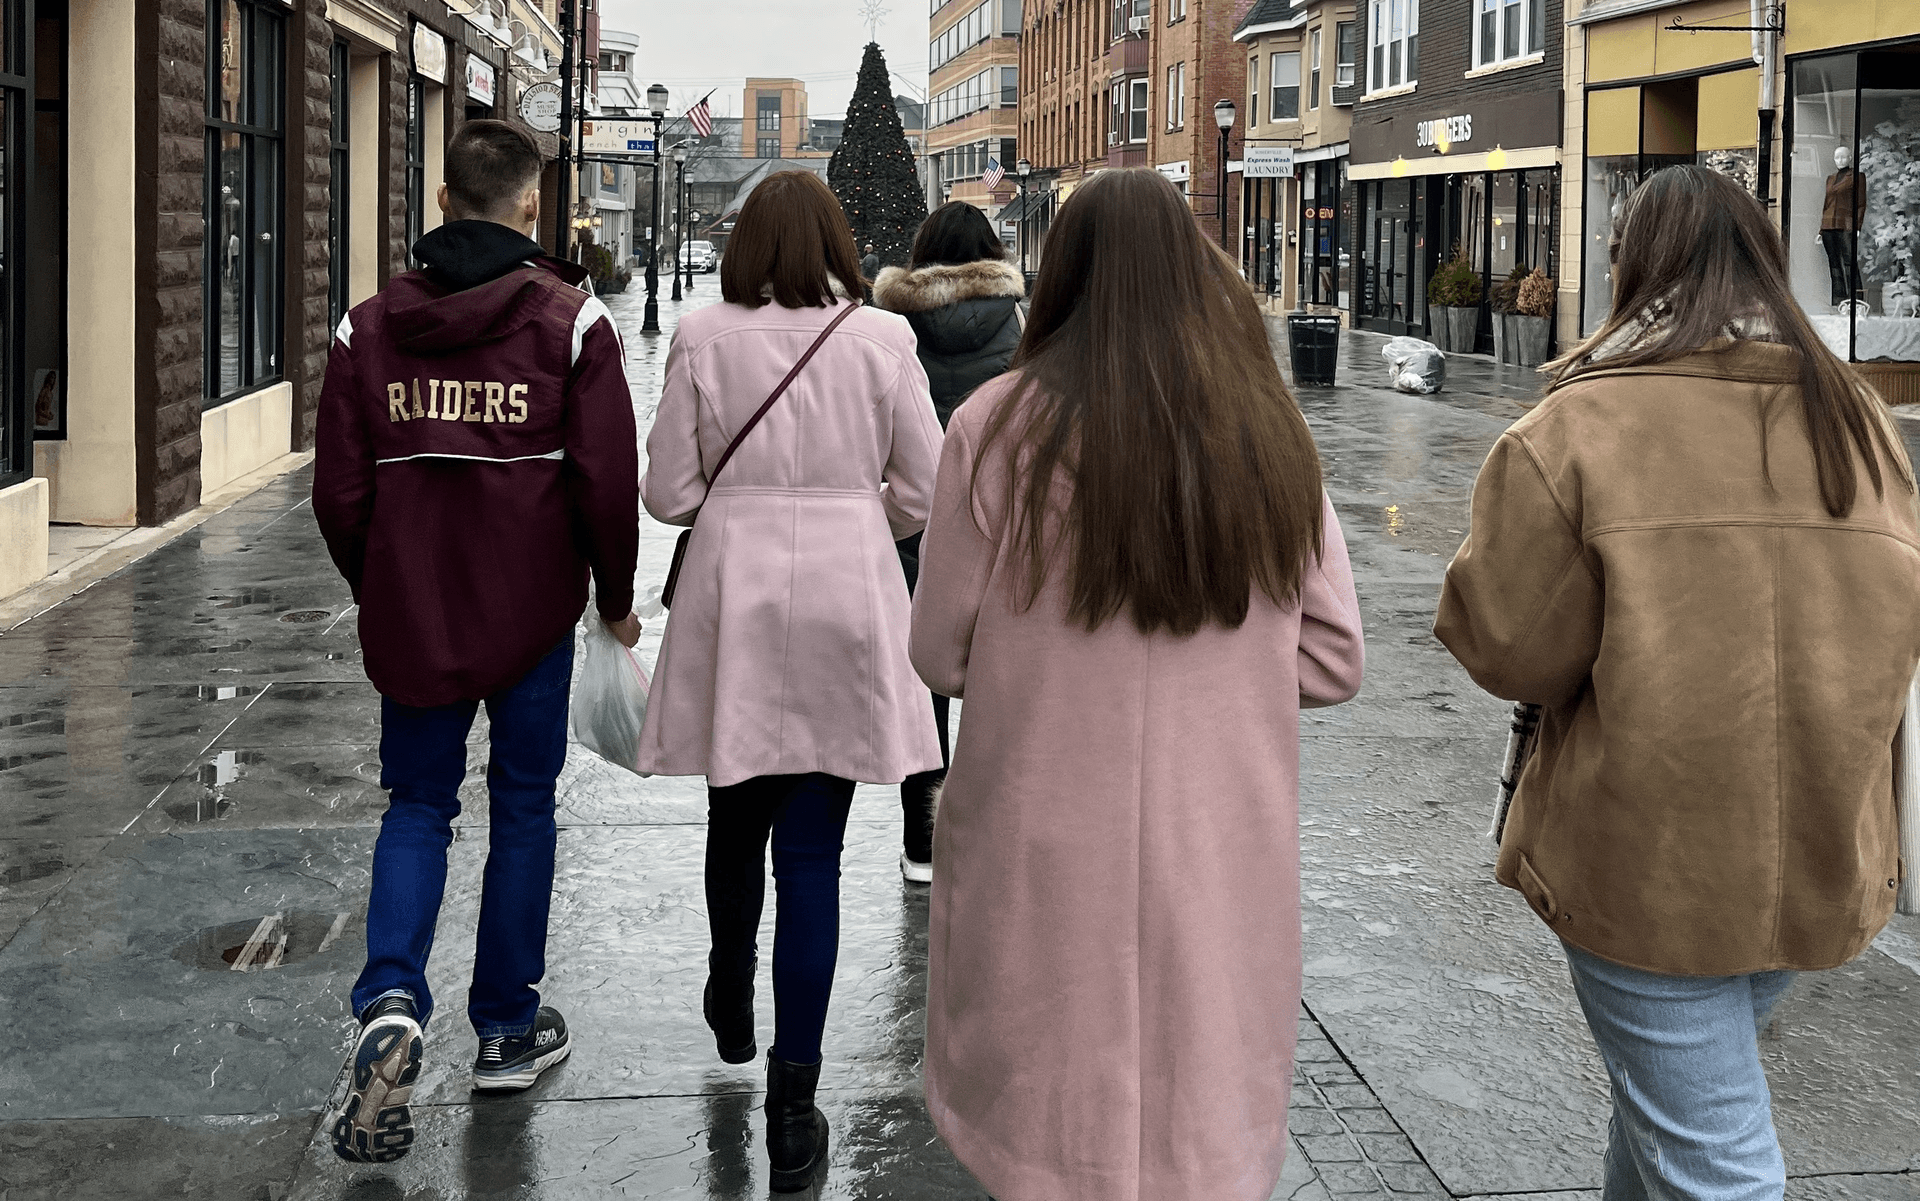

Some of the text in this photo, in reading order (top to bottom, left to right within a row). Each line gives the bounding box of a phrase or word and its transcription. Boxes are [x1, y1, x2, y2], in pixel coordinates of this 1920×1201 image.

[523, 85, 549, 109] DIVISION
[583, 140, 617, 149] rench
[1247, 166, 1290, 174] LAUNDRY
[1305, 208, 1333, 219] OEN
[387, 377, 529, 423] RAIDERS
[535, 1027, 557, 1046] HOKA
